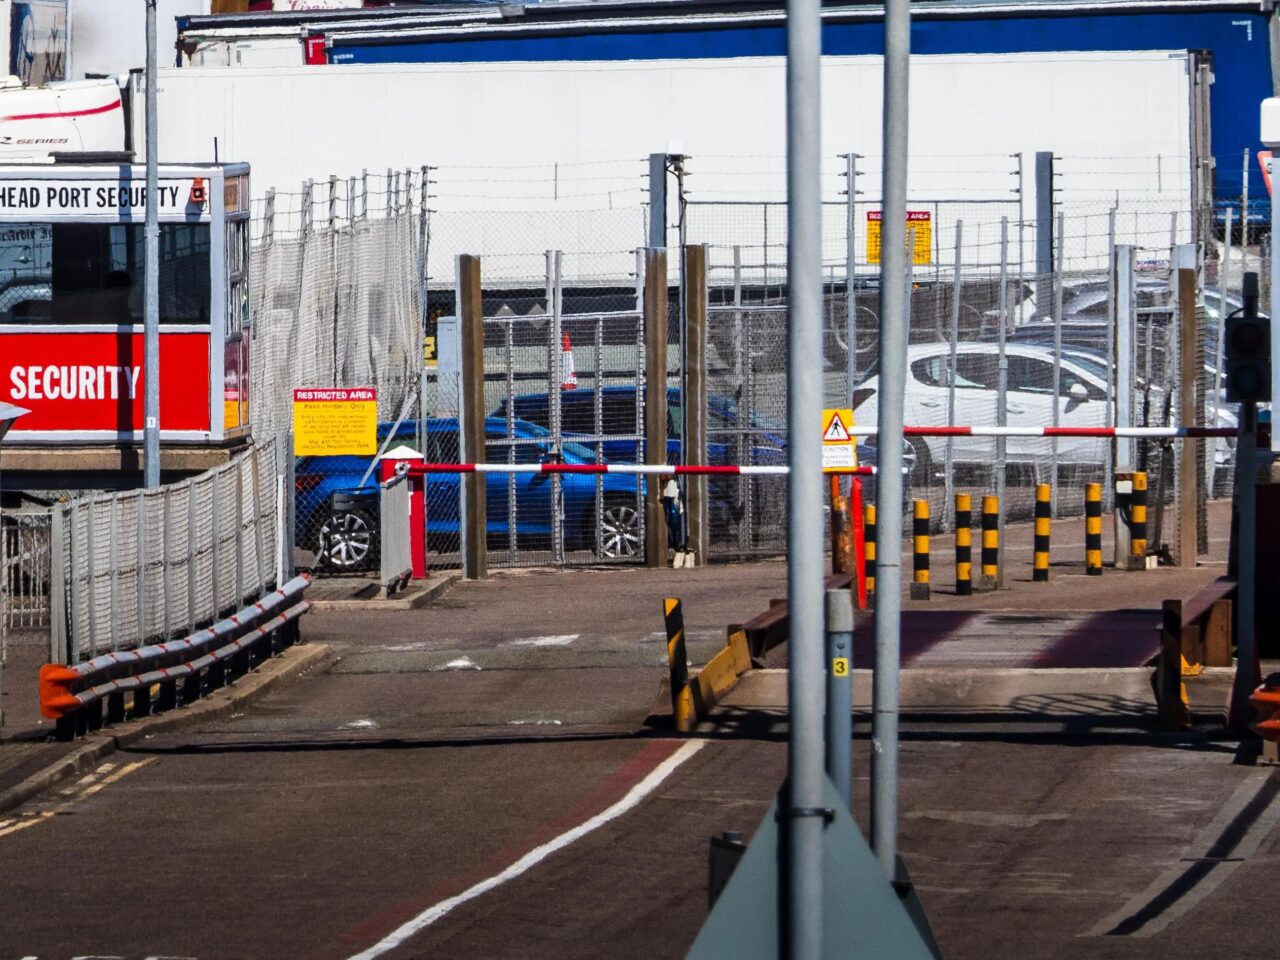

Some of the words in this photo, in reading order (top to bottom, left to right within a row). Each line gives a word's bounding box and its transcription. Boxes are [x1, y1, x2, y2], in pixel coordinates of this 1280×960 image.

[16, 137, 69, 145] SERIES
[47, 186, 92, 208] PORT
[96, 186, 180, 208] SECUTY
[9, 365, 141, 400] SECURITY
[296, 391, 348, 400] RESTRICTED
[349, 390, 374, 400] AREA
[835, 660, 845, 674] 3
